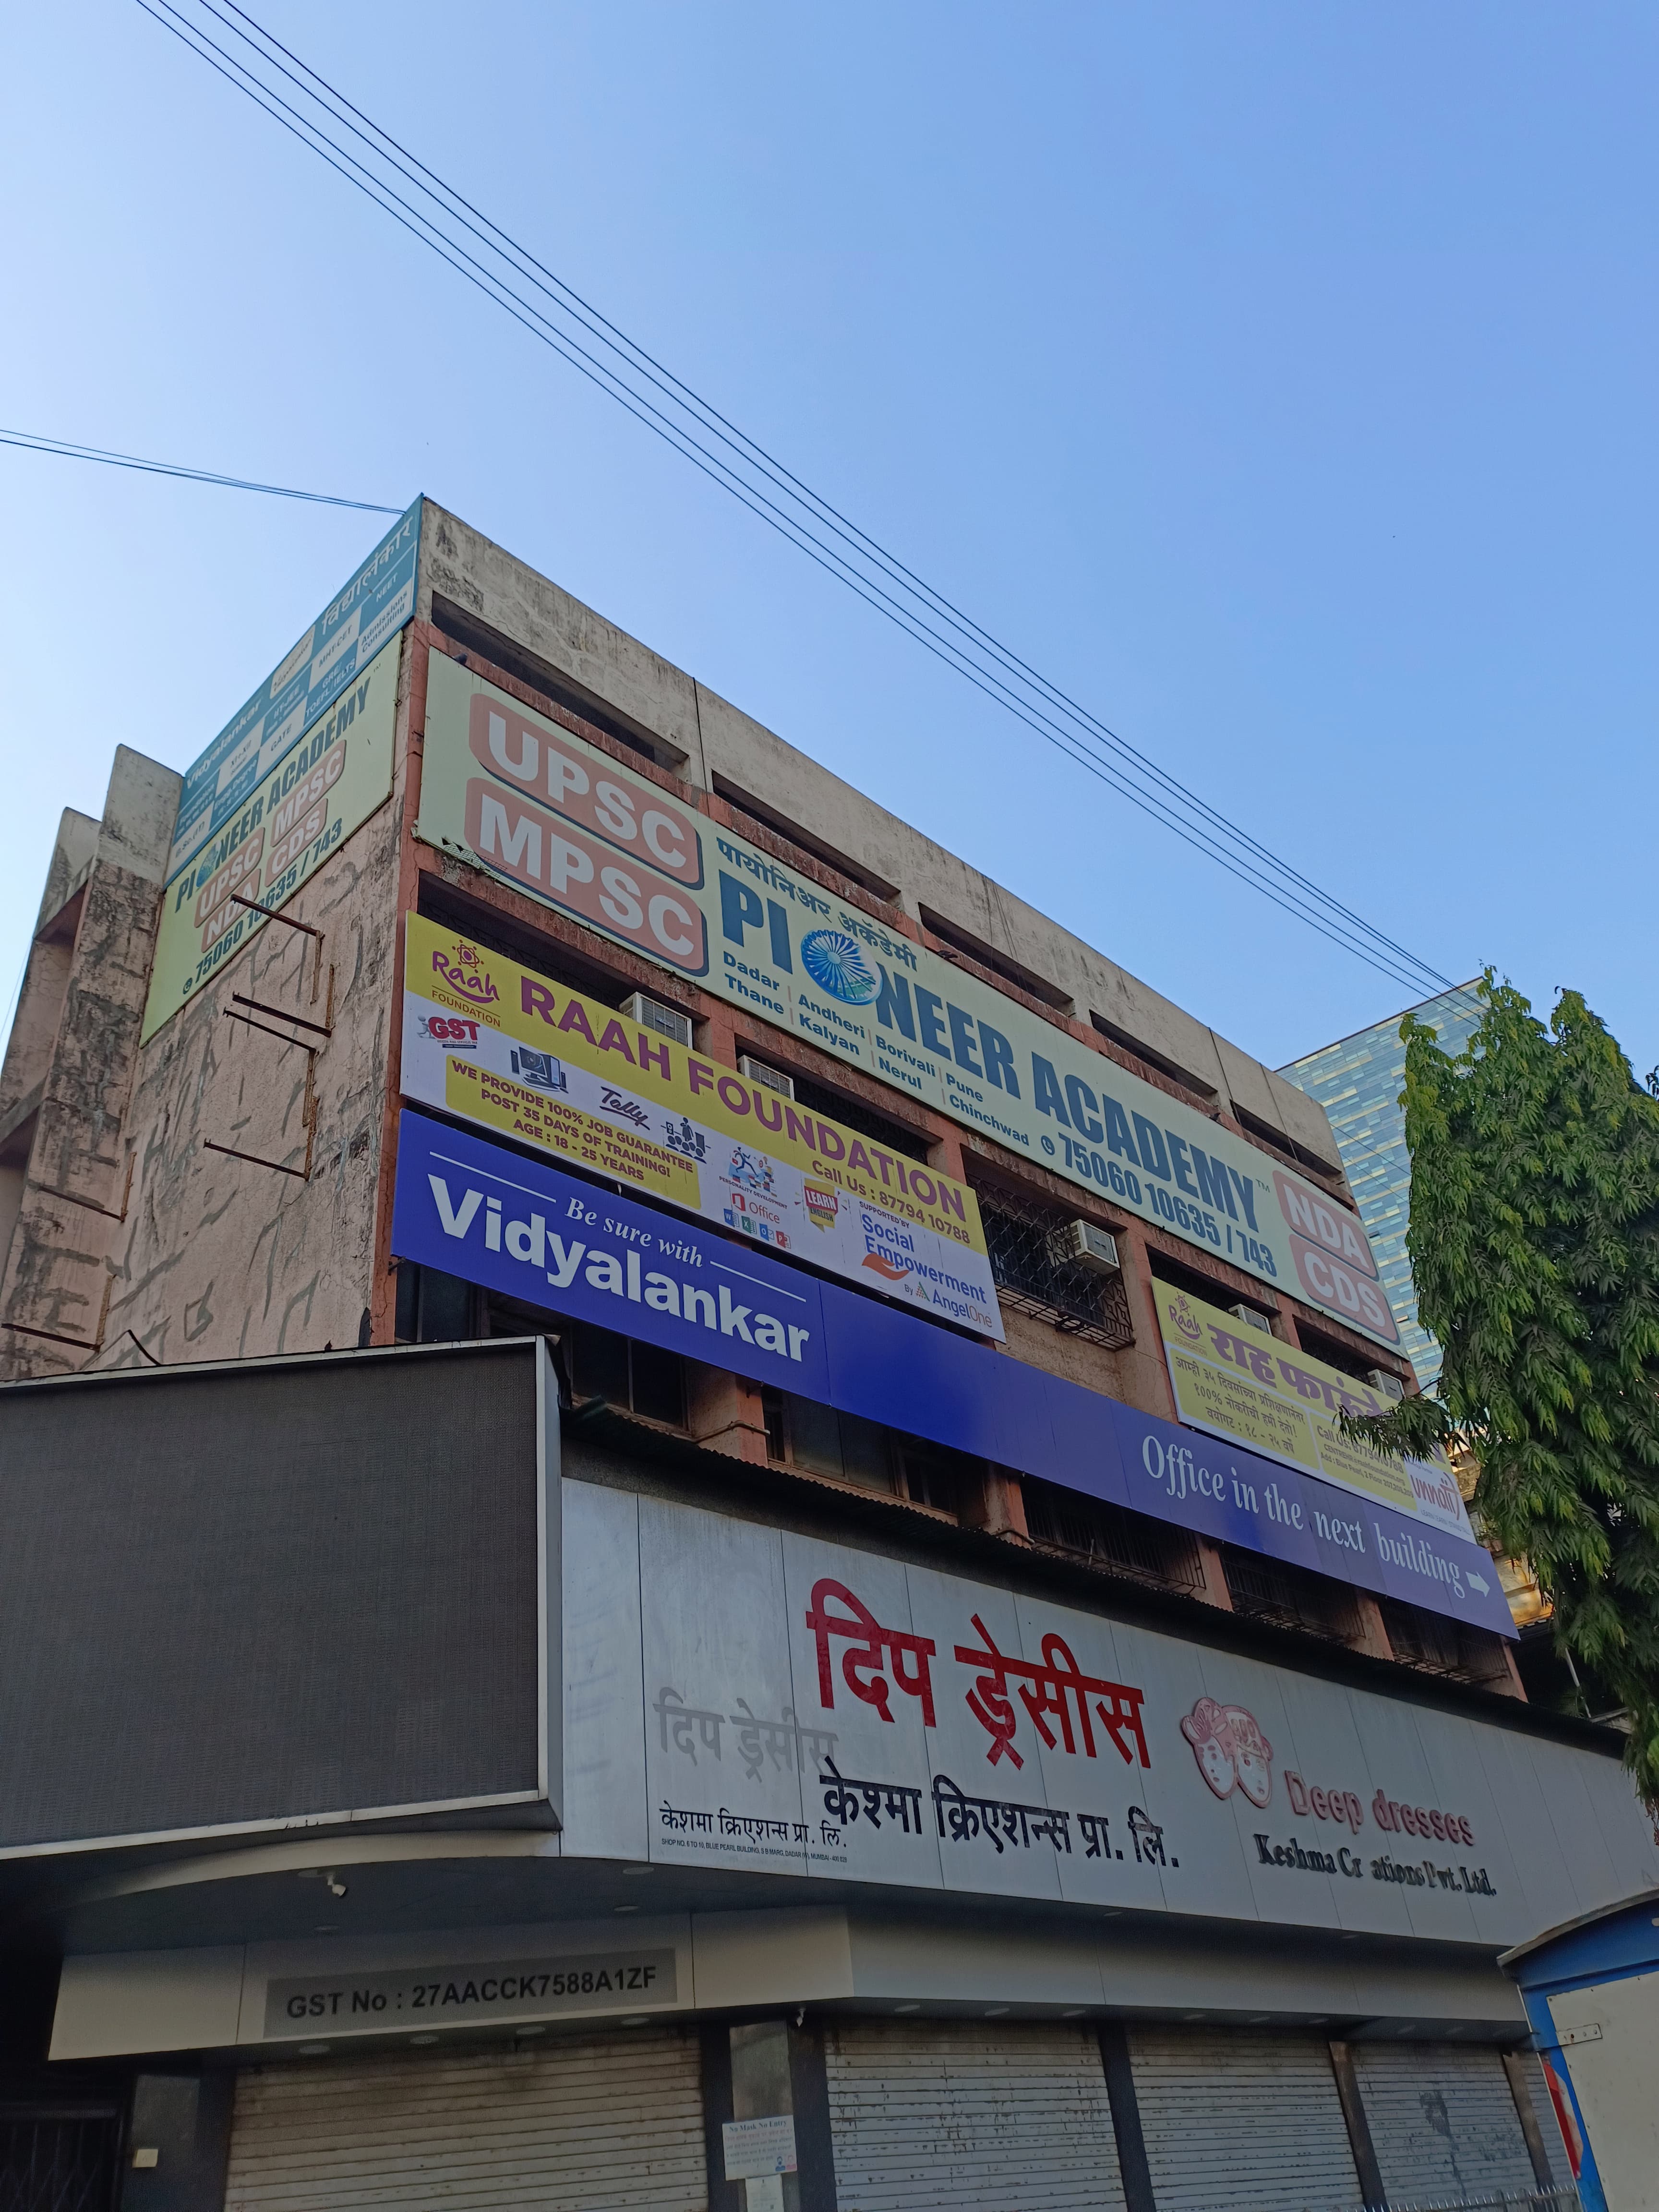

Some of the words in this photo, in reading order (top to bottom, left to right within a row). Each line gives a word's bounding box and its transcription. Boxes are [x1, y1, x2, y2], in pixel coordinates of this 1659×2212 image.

[322, 516, 413, 635] विद्यालंकार
[376, 572, 398, 603] NEET
[361, 590, 407, 646] Admissions
[362, 603, 405, 653] Consulting
[266, 676, 371, 815] ACADEMY
[271, 723, 292, 751] GATE
[274, 749, 342, 842] MPSC
[489, 710, 686, 867] UPSC
[271, 812, 321, 875] CDS
[481, 793, 694, 956] MPSC
[195, 920, 243, 983] 75060
[312, 817, 342, 857] 743
[200, 838, 258, 918] UPSC
[716, 836, 832, 922] पायोनिअर
[432, 989, 500, 1027] FOUNDATION
[433, 950, 500, 1003] Raah
[428, 1017, 480, 1040] GST
[723, 950, 780, 991] Dadar
[798, 994, 866, 1039] Andheri
[876, 1034, 936, 1078] Borivali
[946, 1072, 984, 1103] Pune
[725, 974, 784, 1015] Thane
[799, 1012, 860, 1056] Kalyan
[879, 1056, 922, 1090] Nerul
[950, 1094, 1029, 1146] Chinchwad
[452, 1060, 477, 1080] WE
[481, 1072, 544, 1108] PROVIDE
[547, 1102, 583, 1125] 100%
[587, 1119, 613, 1138] JOB
[616, 1132, 693, 1173] GUARANTEE
[521, 975, 671, 1081] RAAH
[688, 1057, 966, 1222] FOUNDATION
[600, 1086, 649, 1127] Tally
[481, 1088, 519, 1112] POST
[523, 1106, 540, 1121] 35
[544, 1115, 579, 1138] DAYS
[583, 1132, 601, 1146] OF
[605, 1141, 671, 1177] TRAINING!
[513, 1119, 543, 1139] AGE
[554, 1135, 568, 1149] 18
[581, 1146, 597, 1161] 25
[600, 1153, 644, 1180] YEARS
[1032, 1051, 1259, 1233] ACADEMY
[719, 1176, 753, 1195] PERSONALITY
[753, 1190, 788, 1209] DEVELOPMENT
[749, 1202, 780, 1224] Office
[805, 1189, 837, 1210] LEARN
[810, 1207, 834, 1222] ENGLISH
[812, 1161, 842, 1185] Call
[847, 1175, 866, 1196] Us
[879, 1191, 925, 1223] 87794
[928, 1214, 970, 1244] 10788
[859, 1201, 899, 1223] SUPPORTED
[901, 1220, 910, 1229] BY
[1058, 1132, 1142, 1205] 75060
[1145, 1183, 1221, 1247] 10635
[1237, 1229, 1277, 1277] 743
[565, 1197, 597, 1226] Be
[603, 1218, 652, 1248] sure
[658, 1238, 703, 1268] with
[862, 1214, 914, 1252] Social
[1285, 1185, 1369, 1274] NDA
[427, 1173, 810, 1362] Vidyalankar
[865, 1235, 987, 1304] Empowerment
[904, 1284, 913, 1295] By
[1304, 1251, 1385, 1327] CDS
[1168, 1304, 1202, 1340] Raah
[1175, 1336, 1207, 1356] FOUNDATION
[1176, 1356, 1201, 1377] आम्ही
[1203, 1369, 1215, 1384] ३५
[1206, 1323, 1277, 1388] राह
[1205, 1406, 1235, 1429] वयोगट
[1261, 1412, 1277, 1432] हमी
[1317, 1425, 1335, 1443] Call
[1142, 1435, 1226, 1501] Office
[1231, 1467, 1259, 1514] in
[1264, 1483, 1303, 1530] the
[1313, 1511, 1366, 1553] next
[1373, 1523, 1465, 1598] building
[805, 1578, 936, 1727] दिप
[953, 1613, 1151, 1770] ड्रेसीस
[659, 1800, 713, 1834] केशमा
[718, 1808, 788, 1844] क्रिएशन्स
[792, 1823, 815, 1844] प्रा.
[820, 1820, 847, 1848] लि.
[932, 1774, 1072, 1854] क्रिएशन्स
[1077, 1813, 1124, 1861] प्रा.
[1128, 1806, 1179, 1868] लि.
[1285, 1770, 1364, 1835] Deep
[1372, 1789, 1476, 1847] dresses
[661, 1838, 676, 1846] SHOP
[706, 1842, 720, 1851] BLUE
[720, 1843, 736, 1851] PEARL
[769, 1848, 784, 1857] MARG,
[785, 1850, 801, 1859] DADAR
[811, 1852, 829, 1862] MUMBAI
[1252, 1833, 1337, 1875] Keshma
[1459, 1866, 1497, 1897] Ltd.
[288, 1992, 343, 2018] GST
[352, 1990, 387, 2013] No
[412, 1966, 657, 2008] 27AACCK7588A1ZF
